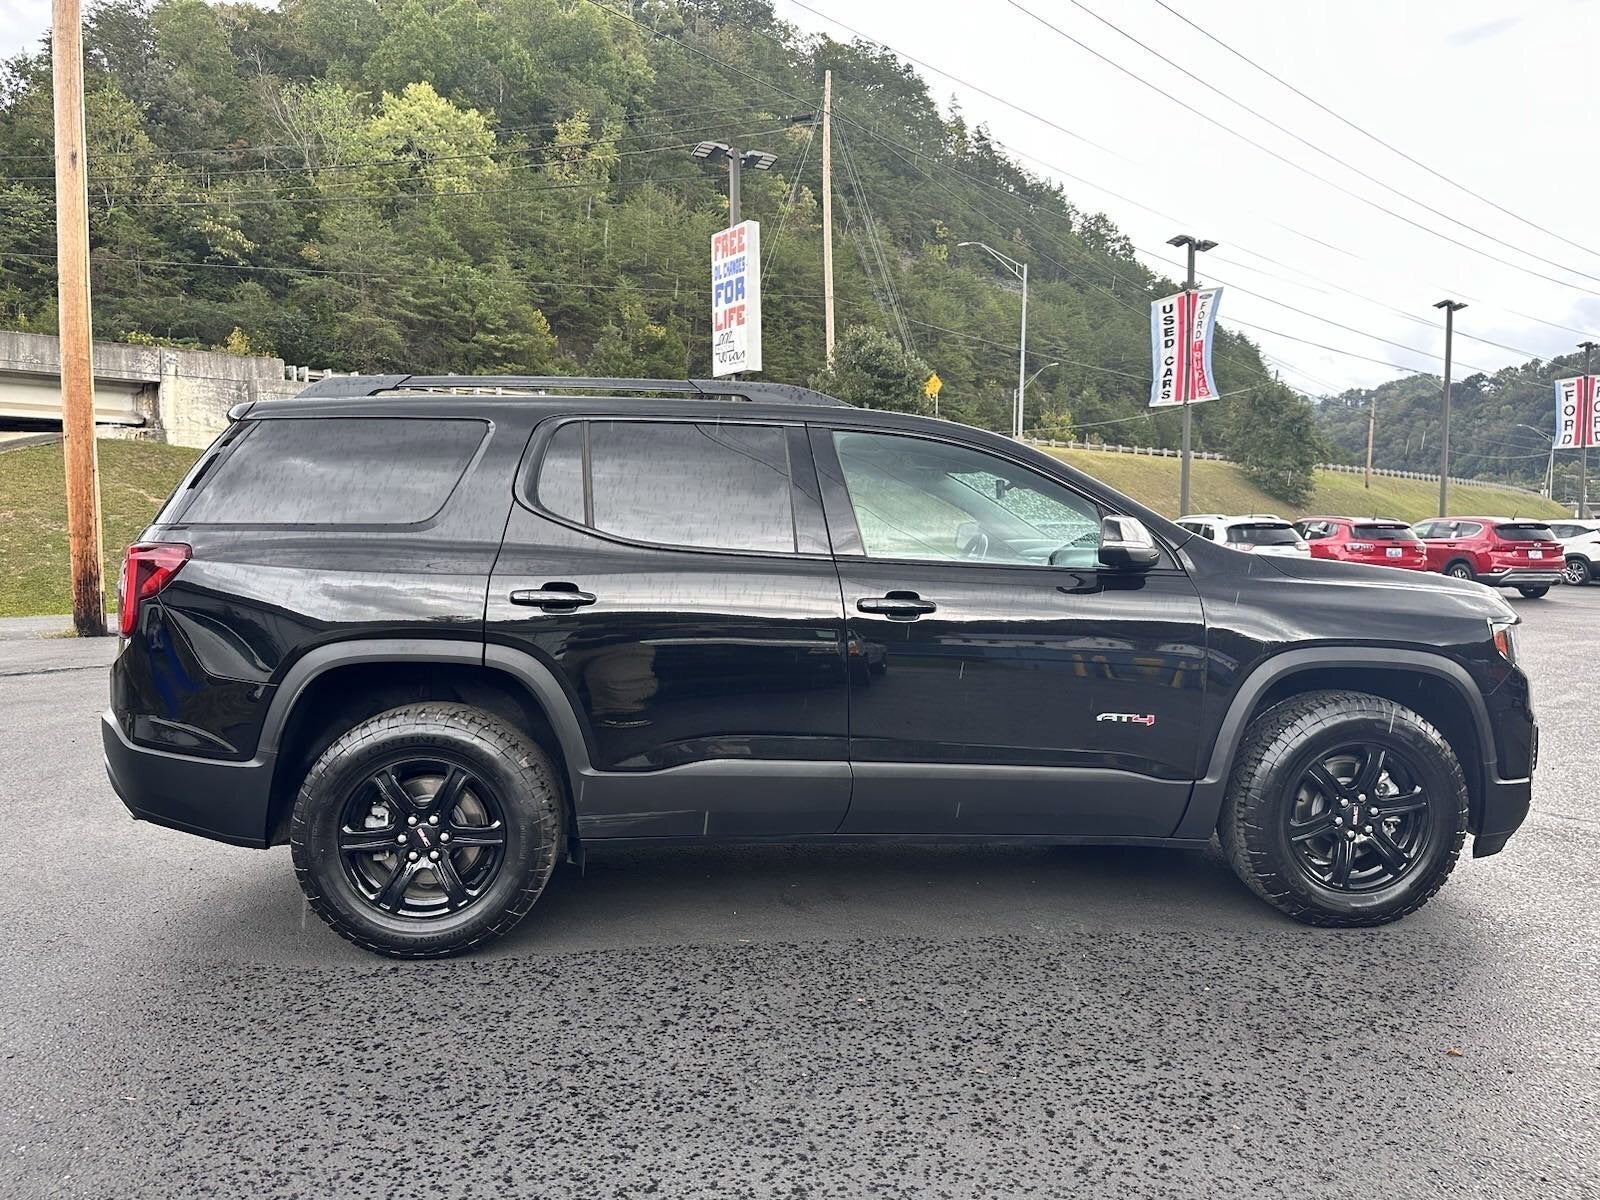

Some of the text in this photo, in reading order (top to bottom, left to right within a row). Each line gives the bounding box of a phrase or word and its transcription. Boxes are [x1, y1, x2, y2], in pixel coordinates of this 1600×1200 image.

[714, 227, 745, 262] FREE
[715, 276, 745, 308] FOR
[715, 304, 745, 332] LIFE
[1195, 301, 1207, 340] FORD
[1161, 303, 1175, 400] USED CARS
[1562, 389, 1576, 445] FORD
[1096, 712, 1155, 726] AT4
